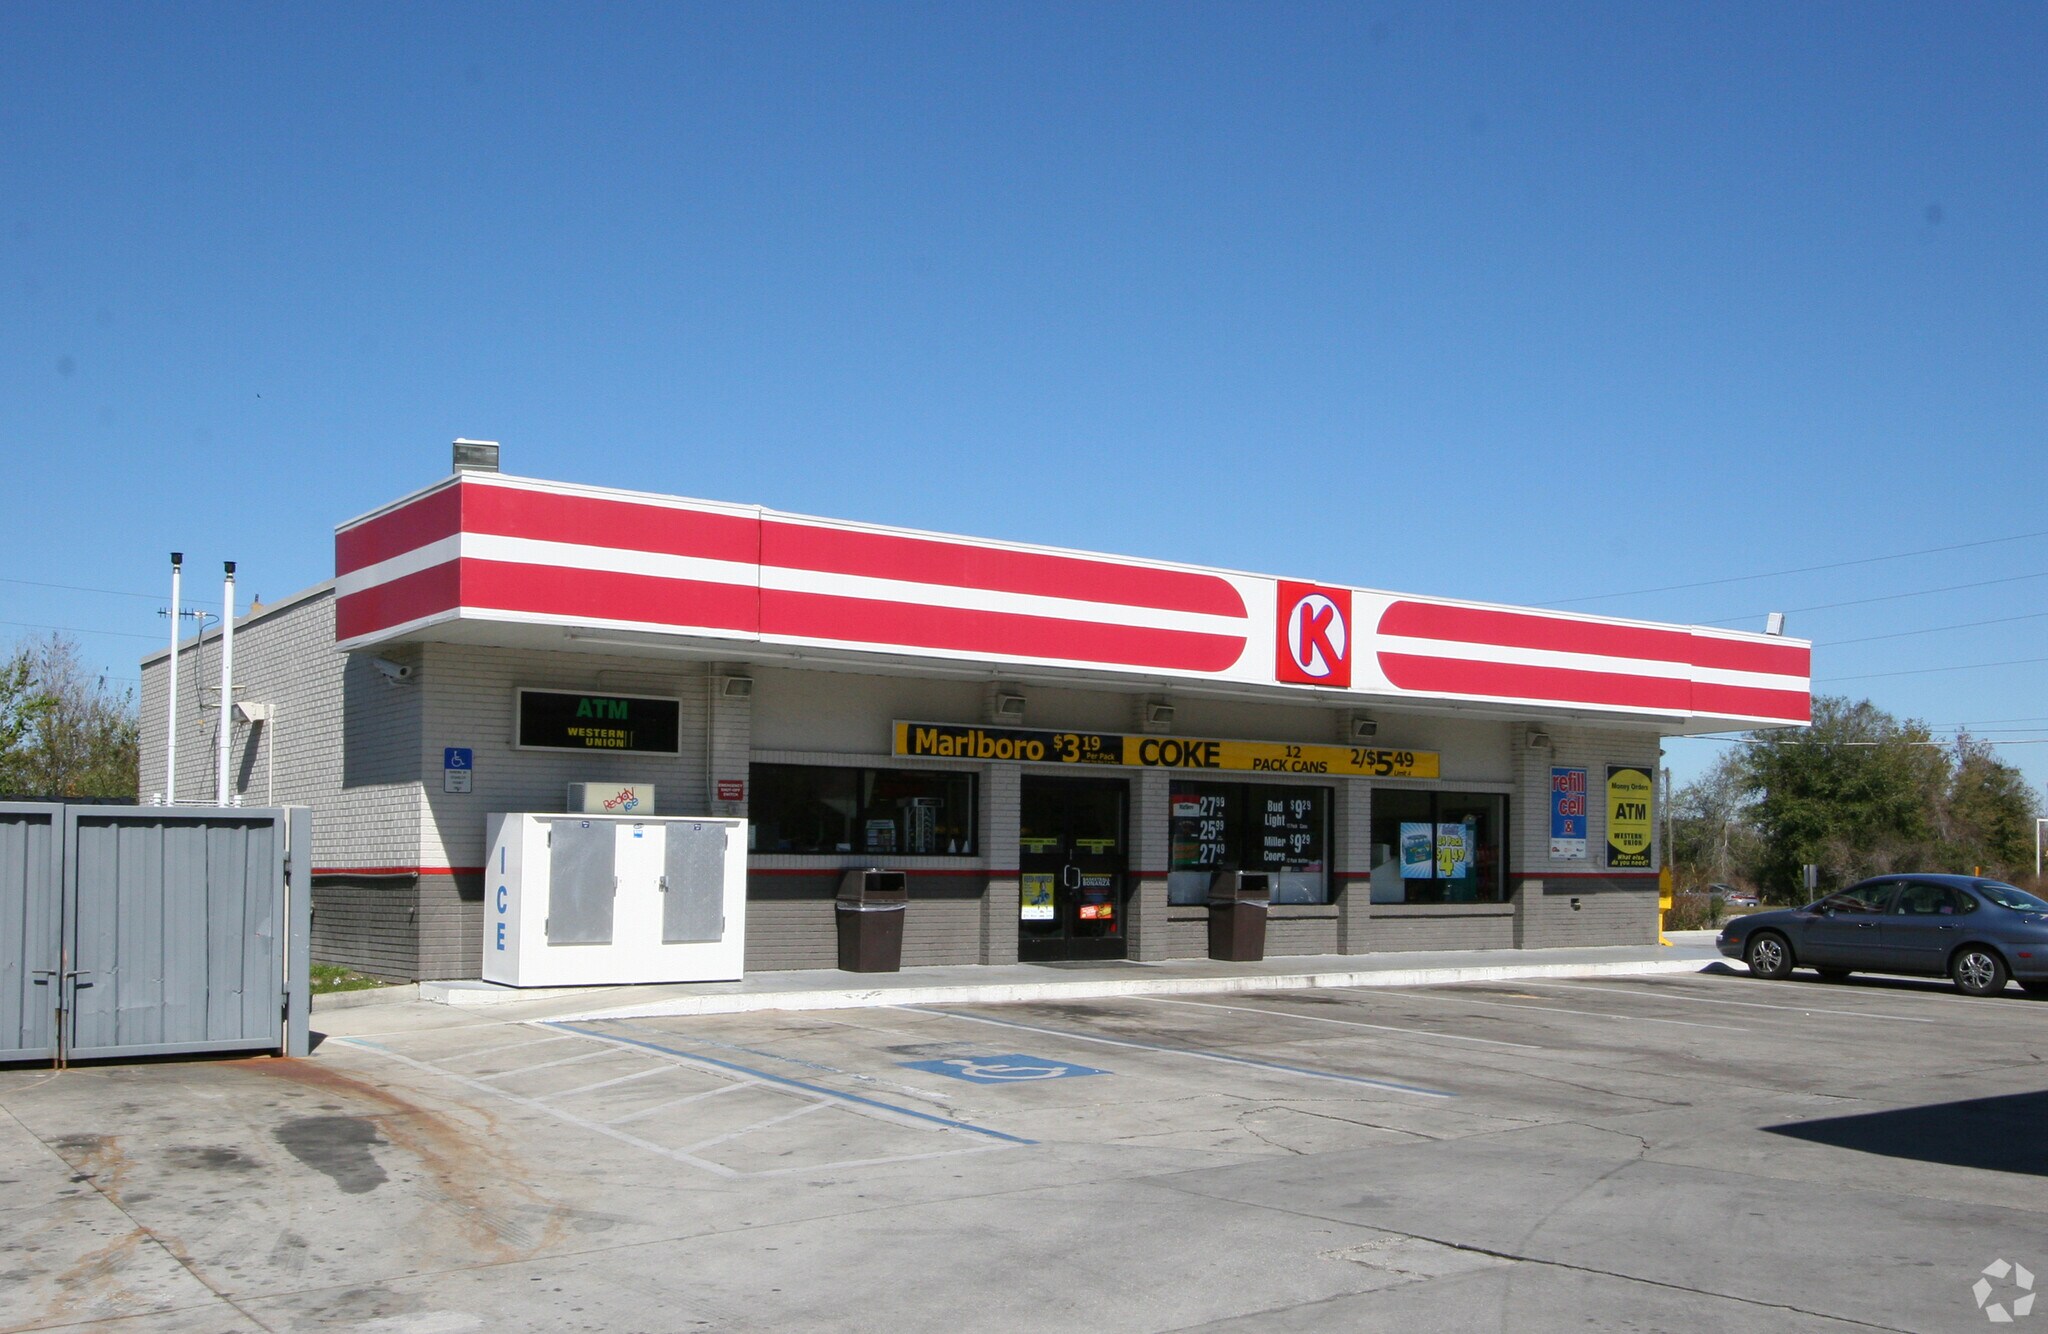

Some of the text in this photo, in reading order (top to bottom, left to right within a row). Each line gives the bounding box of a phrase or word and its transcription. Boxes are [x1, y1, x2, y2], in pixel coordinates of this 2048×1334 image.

[1299, 602, 1341, 675] K
[576, 698, 628, 720] ATM
[568, 727, 624, 738] WESTERN
[586, 738, 624, 747] UNION
[915, 727, 1045, 761] Marlboro
[1139, 738, 1221, 768] COKE
[1285, 745, 1301, 758] 12
[1253, 758, 1328, 773] PACK CANS
[1552, 771, 1585, 793] refill
[1611, 782, 1649, 791] Money Orders
[603, 786, 635, 813] Reddy
[1267, 800, 1283, 812] Bud
[1558, 794, 1585, 816] cell
[1615, 802, 1646, 820] ATM
[1264, 813, 1285, 828] Light
[1264, 836, 1287, 847] Miller
[1614, 832, 1642, 840] WESTERN
[1263, 850, 1286, 861] Coors
